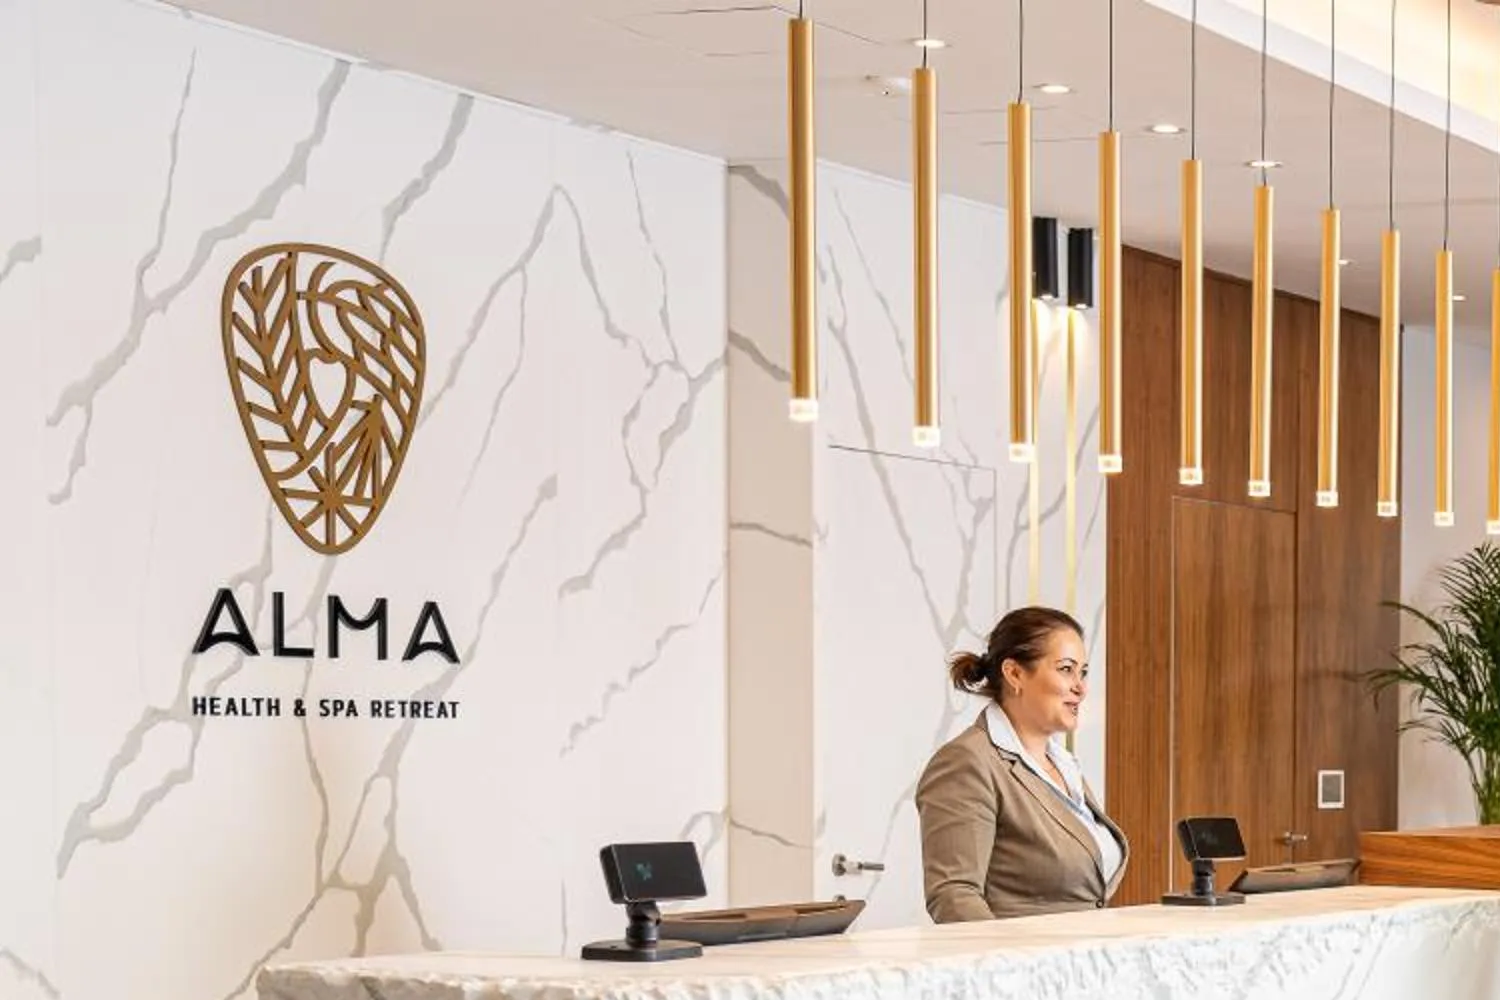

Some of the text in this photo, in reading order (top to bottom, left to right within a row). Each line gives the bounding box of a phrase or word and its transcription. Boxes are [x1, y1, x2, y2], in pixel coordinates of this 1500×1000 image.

[191, 587, 461, 665] ALMA
[192, 696, 460, 719] HEALTH & SPA RETREAT
